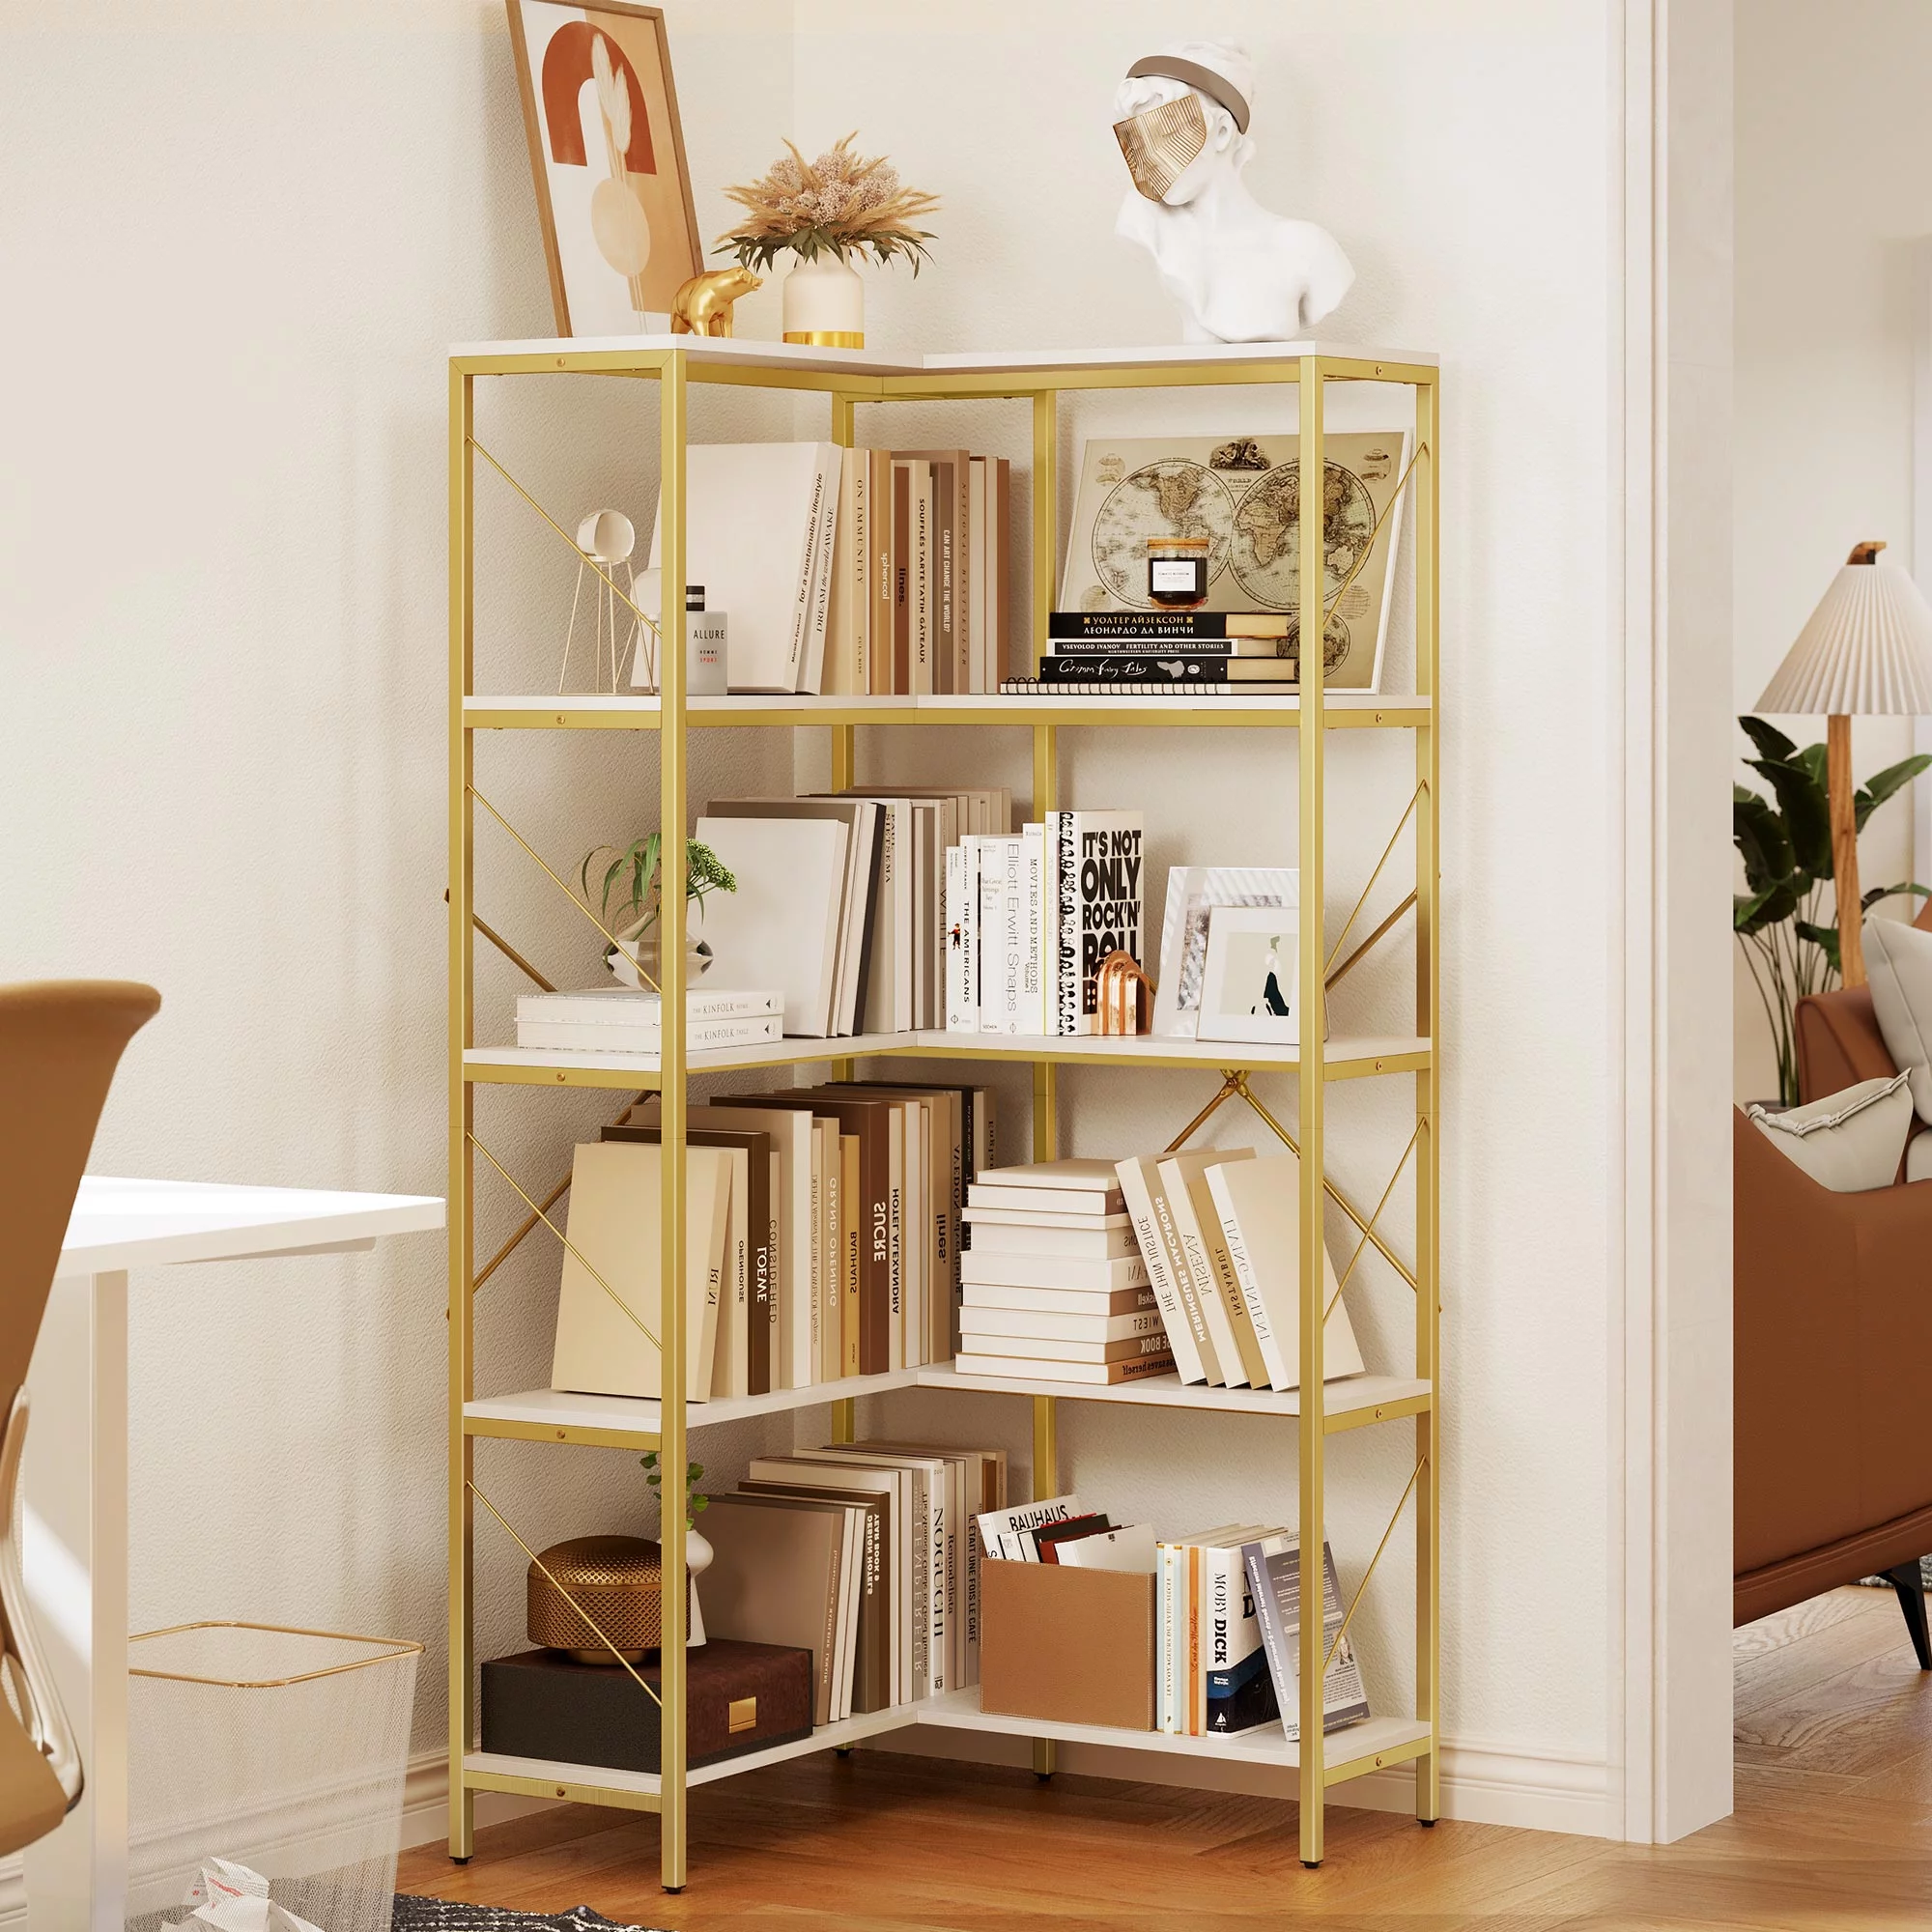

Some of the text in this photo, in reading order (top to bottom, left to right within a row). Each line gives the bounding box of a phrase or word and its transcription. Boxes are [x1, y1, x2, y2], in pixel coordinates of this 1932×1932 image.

[857, 479, 864, 497] ON
[804, 516, 816, 577] sustainable
[811, 472, 823, 514] lifestyle
[816, 588, 826, 633] DREAM
[824, 507, 834, 548] AWAKE
[880, 552, 890, 600] spherical
[918, 551, 926, 582] TARTE
[898, 567, 907, 607] lines.
[918, 584, 926, 613] TATIN
[693, 629, 724, 639] ALLURE
[918, 616, 926, 664] GÂTEAUX
[1083, 626, 1194, 635] ЛЕОНАРДО ДА ВИНЧИ
[1082, 830, 1142, 858] IT'S NOT
[1080, 856, 1142, 903] ONLY
[1005, 843, 1019, 1011] Elliott Erwitt Snaps
[1082, 901, 1141, 930] ROCK'N'
[702, 1003, 735, 1014] KINFOLK
[704, 1028, 735, 1040] KINFOLK
[968, 1514, 977, 1523] IL
[1009, 1504, 1069, 1532] BAUHAUS
[934, 1508, 943, 1638] NOGUCHI
[968, 1555, 977, 1577] UNE
[968, 1578, 977, 1600] FOIS
[968, 1603, 977, 1615] LE
[1214, 1573, 1227, 1664] MOBY DICK
